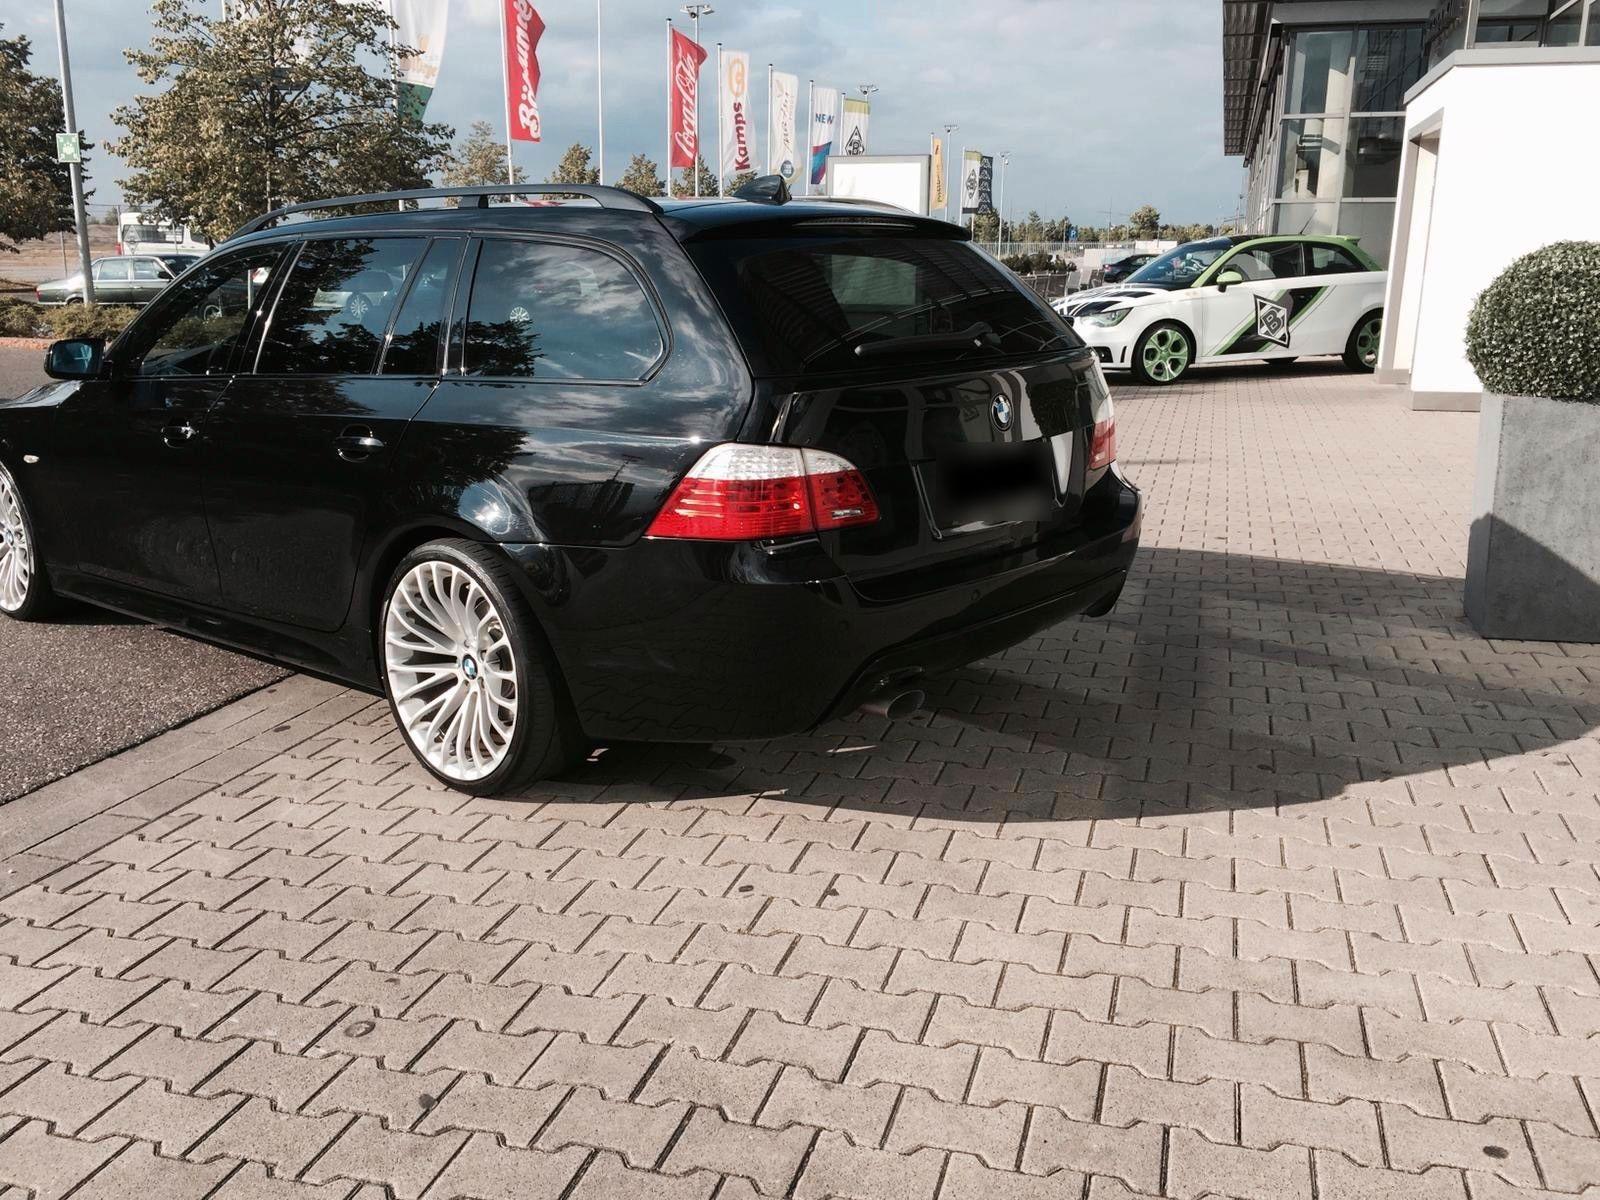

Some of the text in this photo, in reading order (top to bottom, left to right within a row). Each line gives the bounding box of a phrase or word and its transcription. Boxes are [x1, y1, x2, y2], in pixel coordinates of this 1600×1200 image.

[815, 113, 835, 125] NEW
[733, 102, 750, 172] Kamps
[1260, 308, 1284, 337] B
